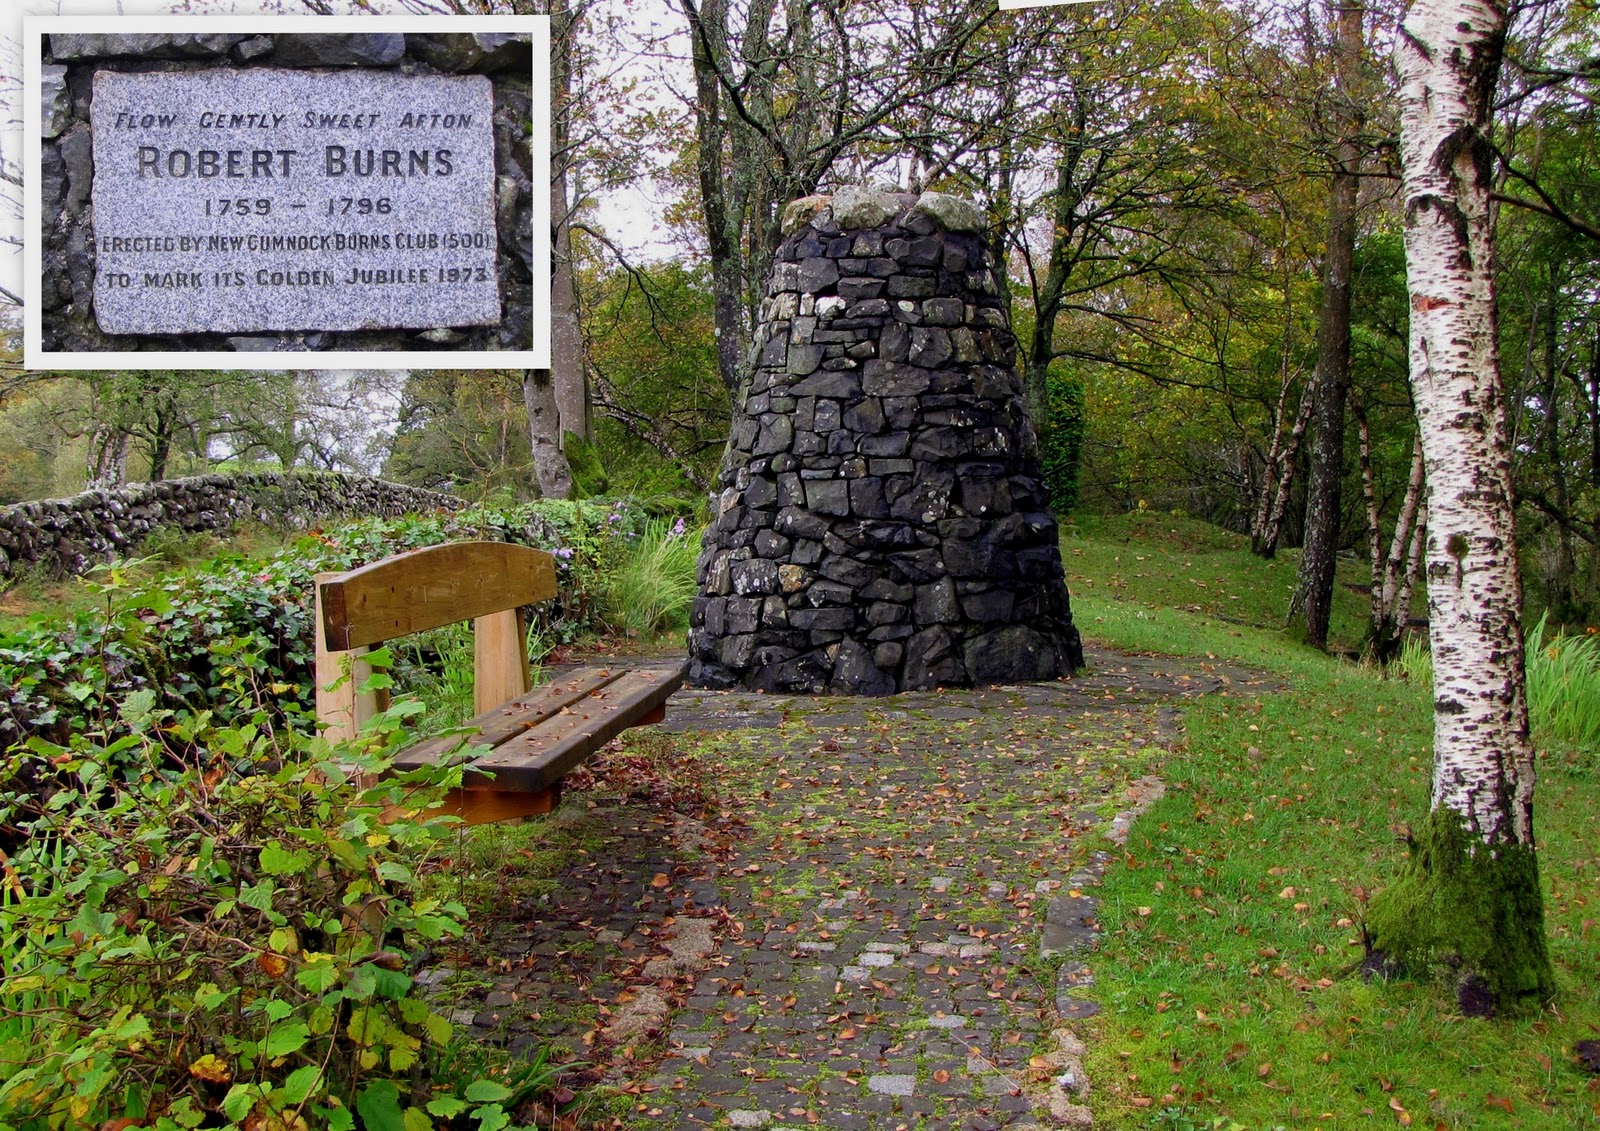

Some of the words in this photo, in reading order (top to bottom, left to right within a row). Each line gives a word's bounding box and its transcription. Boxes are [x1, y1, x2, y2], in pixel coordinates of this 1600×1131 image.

[114, 112, 178, 129] FLOW
[200, 111, 286, 129] GENTLY
[302, 111, 380, 128] SWEET
[399, 112, 472, 129] AFTON
[138, 146, 296, 179] ROBERT
[325, 145, 453, 178] BURNS
[205, 199, 271, 216] 1759
[329, 197, 392, 215] 1796
[102, 236, 174, 252] ERECTED
[180, 235, 206, 252] BY
[208, 235, 244, 251] NEW
[247, 234, 332, 251] CUMNOCK
[335, 233, 391, 251] BURNS
[395, 232, 438, 250] CLUB
[105, 273, 131, 288] TO
[144, 272, 203, 288] MARK
[214, 272, 246, 288] ITS
[344, 267, 428, 285] JUBILEE
[438, 267, 488, 283] 1973
